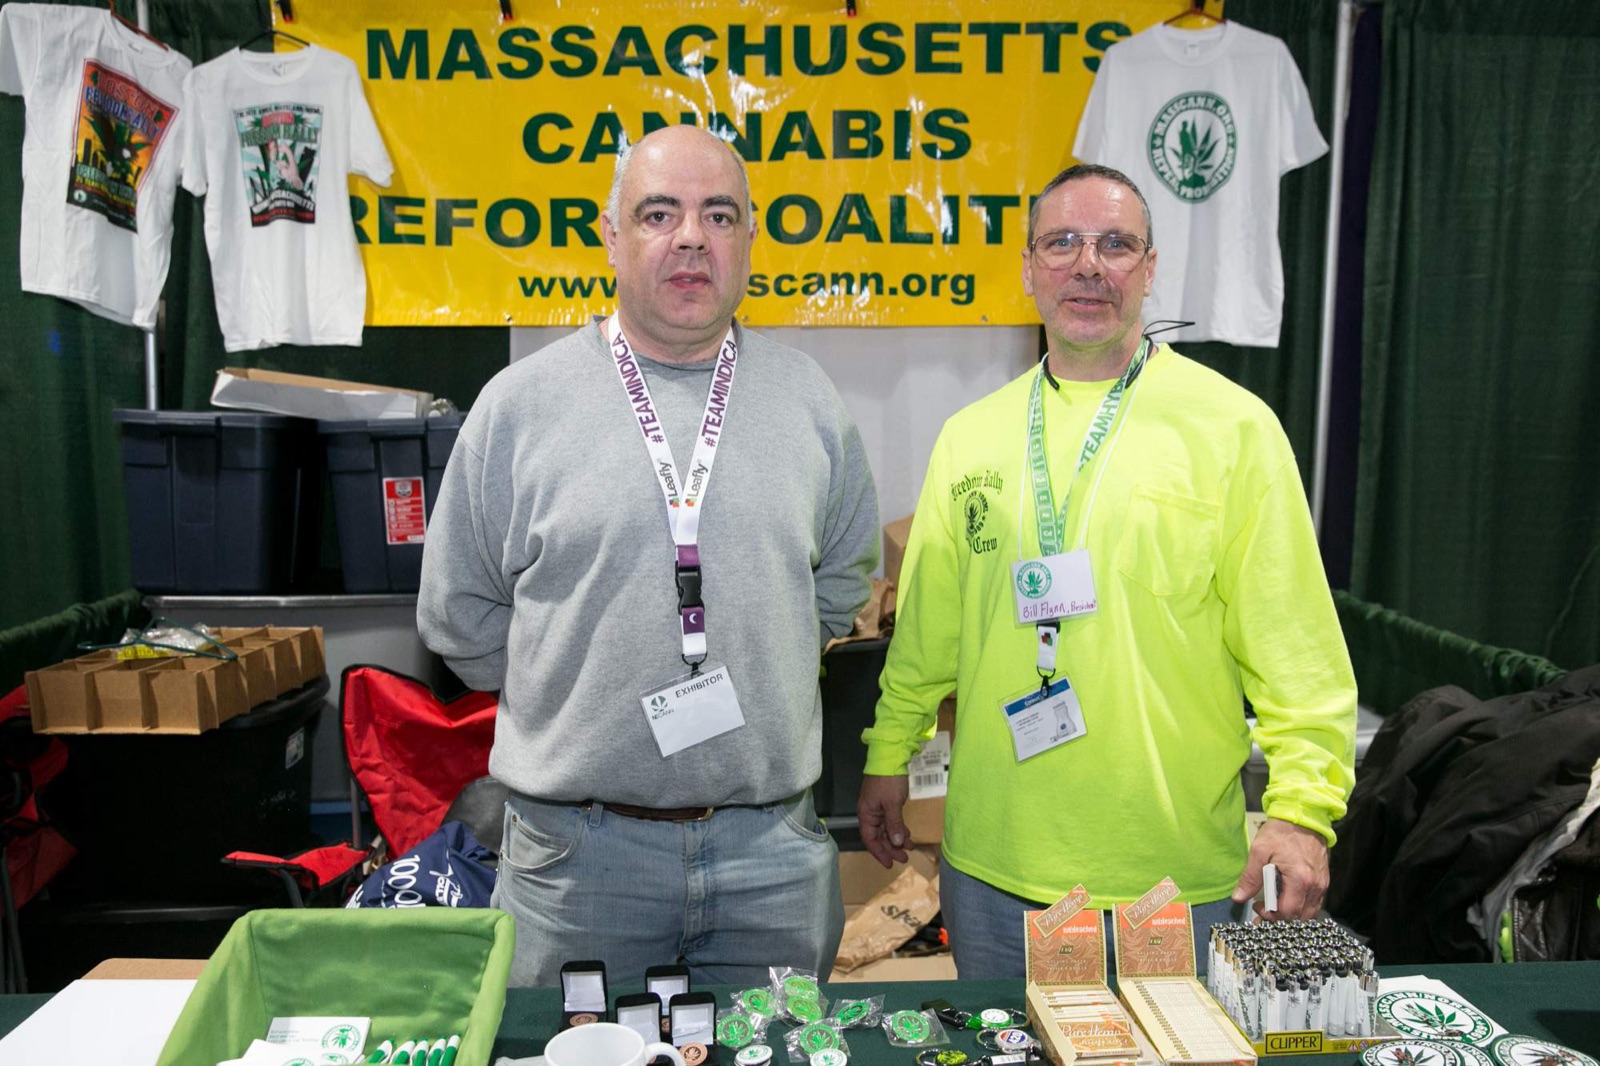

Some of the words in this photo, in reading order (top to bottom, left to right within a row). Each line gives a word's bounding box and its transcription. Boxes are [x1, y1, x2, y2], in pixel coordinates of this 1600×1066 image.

[366, 21, 1132, 81] MASSACHUSETTS
[522, 107, 972, 164] CANABIS
[349, 194, 605, 248] EFOR
[612, 332, 664, 443] #TEAMINDICA
[701, 340, 737, 447] #TEAMINDICA
[659, 462, 678, 497] Leafly
[688, 463, 708, 498] Leafly
[973, 536, 998, 554] Crew
[1023, 604, 1038, 618] Bill
[675, 673, 724, 698] EXHIBITOR
[1062, 925, 1098, 933] unbleached
[1151, 917, 1186, 926] unbleached
[1060, 1024, 1086, 1037] Pure
[1270, 1037, 1318, 1050] CLIPPER
